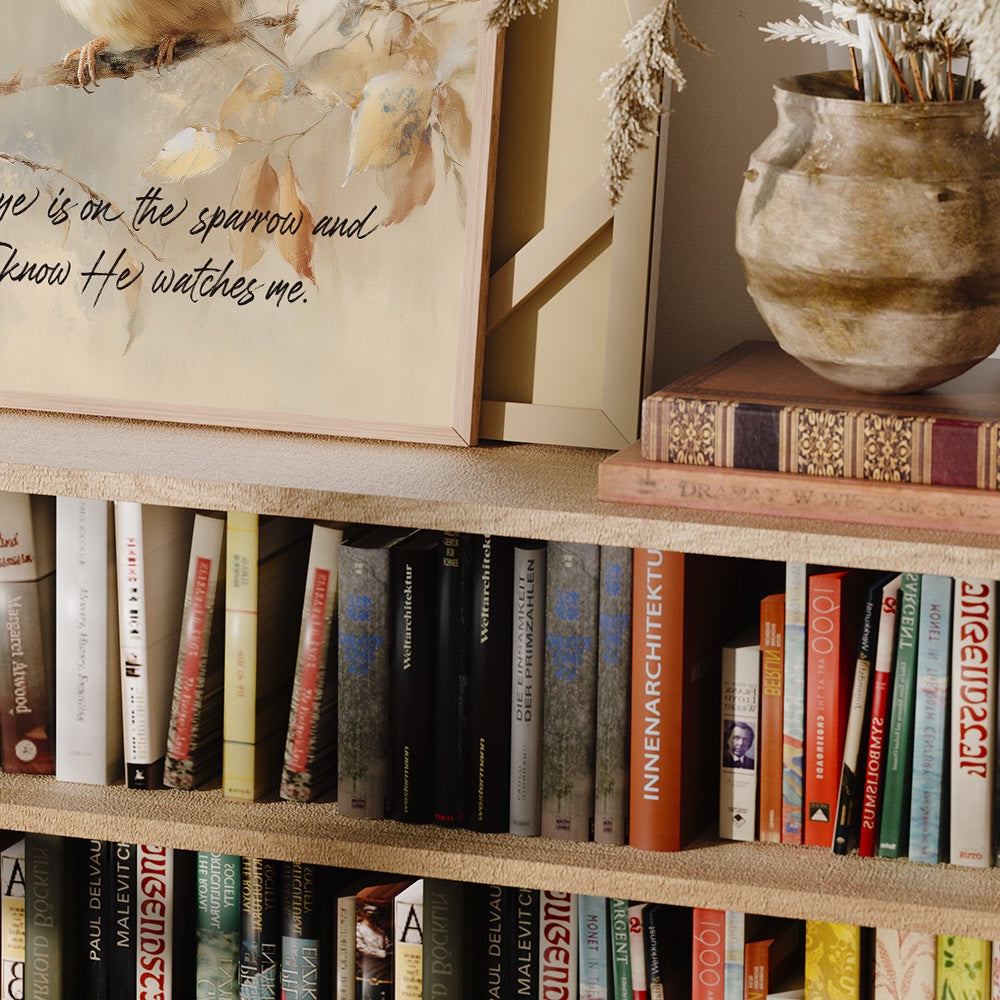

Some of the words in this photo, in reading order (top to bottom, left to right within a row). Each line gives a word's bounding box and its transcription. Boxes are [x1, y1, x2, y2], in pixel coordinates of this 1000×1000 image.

[48, 186, 78, 222] is
[81, 197, 125, 222] on
[132, 188, 189, 231] the
[190, 205, 304, 244] sparrow
[312, 205, 379, 240] and
[81, 247, 146, 308] He
[150, 260, 265, 306] watches
[266, 275, 309, 305] me.
[6, 595, 24, 657] Margaret
[403, 563, 413, 671] Weltarchitektur
[516, 574, 526, 686] EINSAMKEIT
[525, 559, 535, 679] PRIMZAHLEN
[11, 661, 32, 714] Atwood
[516, 692, 524, 722] DIE
[524, 685, 533, 722] DER
[402, 745, 410, 814] westermann
[477, 737, 486, 821] westermann
[89, 839, 101, 910] DELVAU
[89, 916, 101, 961] PAUL
[587, 914, 599, 952] MONET
[648, 926, 660, 975] Werkkunst
[695, 920, 721, 987] 1900
